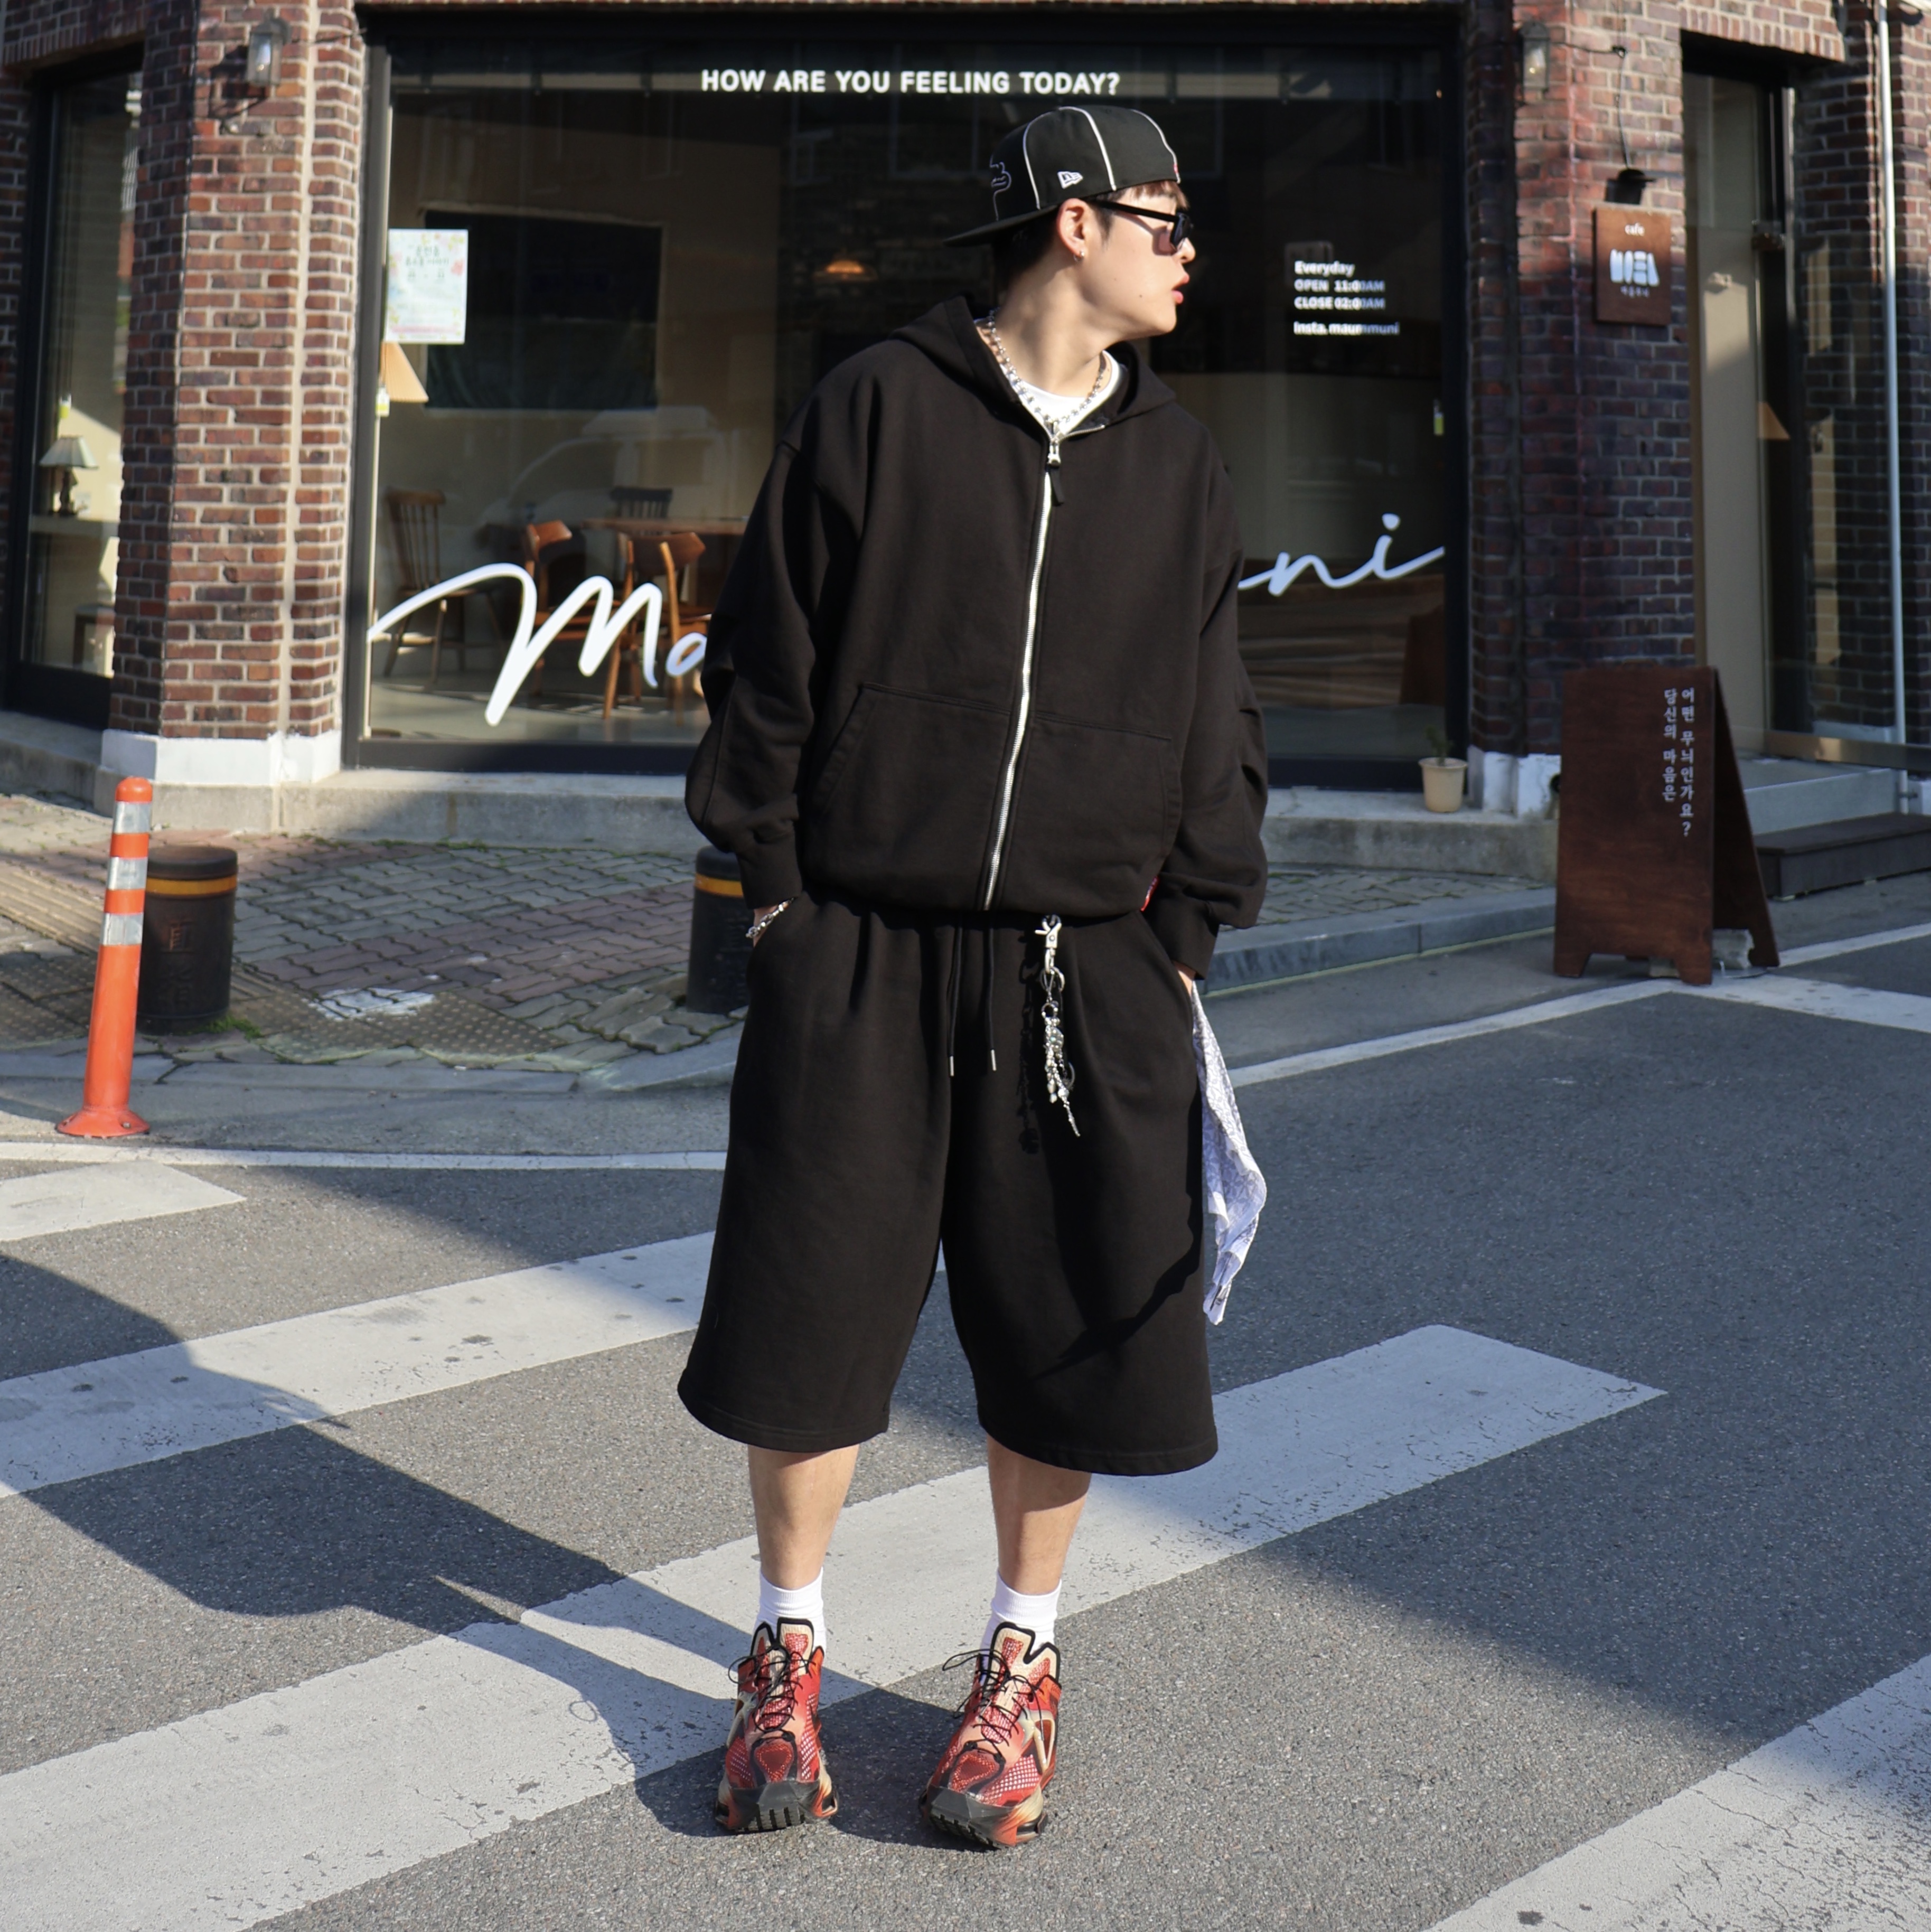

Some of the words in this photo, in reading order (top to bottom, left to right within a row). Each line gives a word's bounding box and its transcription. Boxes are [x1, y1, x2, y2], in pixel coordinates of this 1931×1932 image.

[701, 69, 766, 92] HOW
[773, 70, 826, 92] ARE
[835, 70, 890, 93] YOU
[901, 71, 1010, 94] FEELING
[1019, 72, 1120, 95] TODAY?
[1295, 260, 1355, 277] Everyday
[1294, 279, 1329, 292] OPEN
[1294, 296, 1333, 310] CLOSE
[1663, 688, 1677, 739] 당신의
[1681, 687, 1694, 722] 어떤
[1662, 748, 1677, 802] 마음은
[1680, 730, 1694, 837] 무늬인가요?
